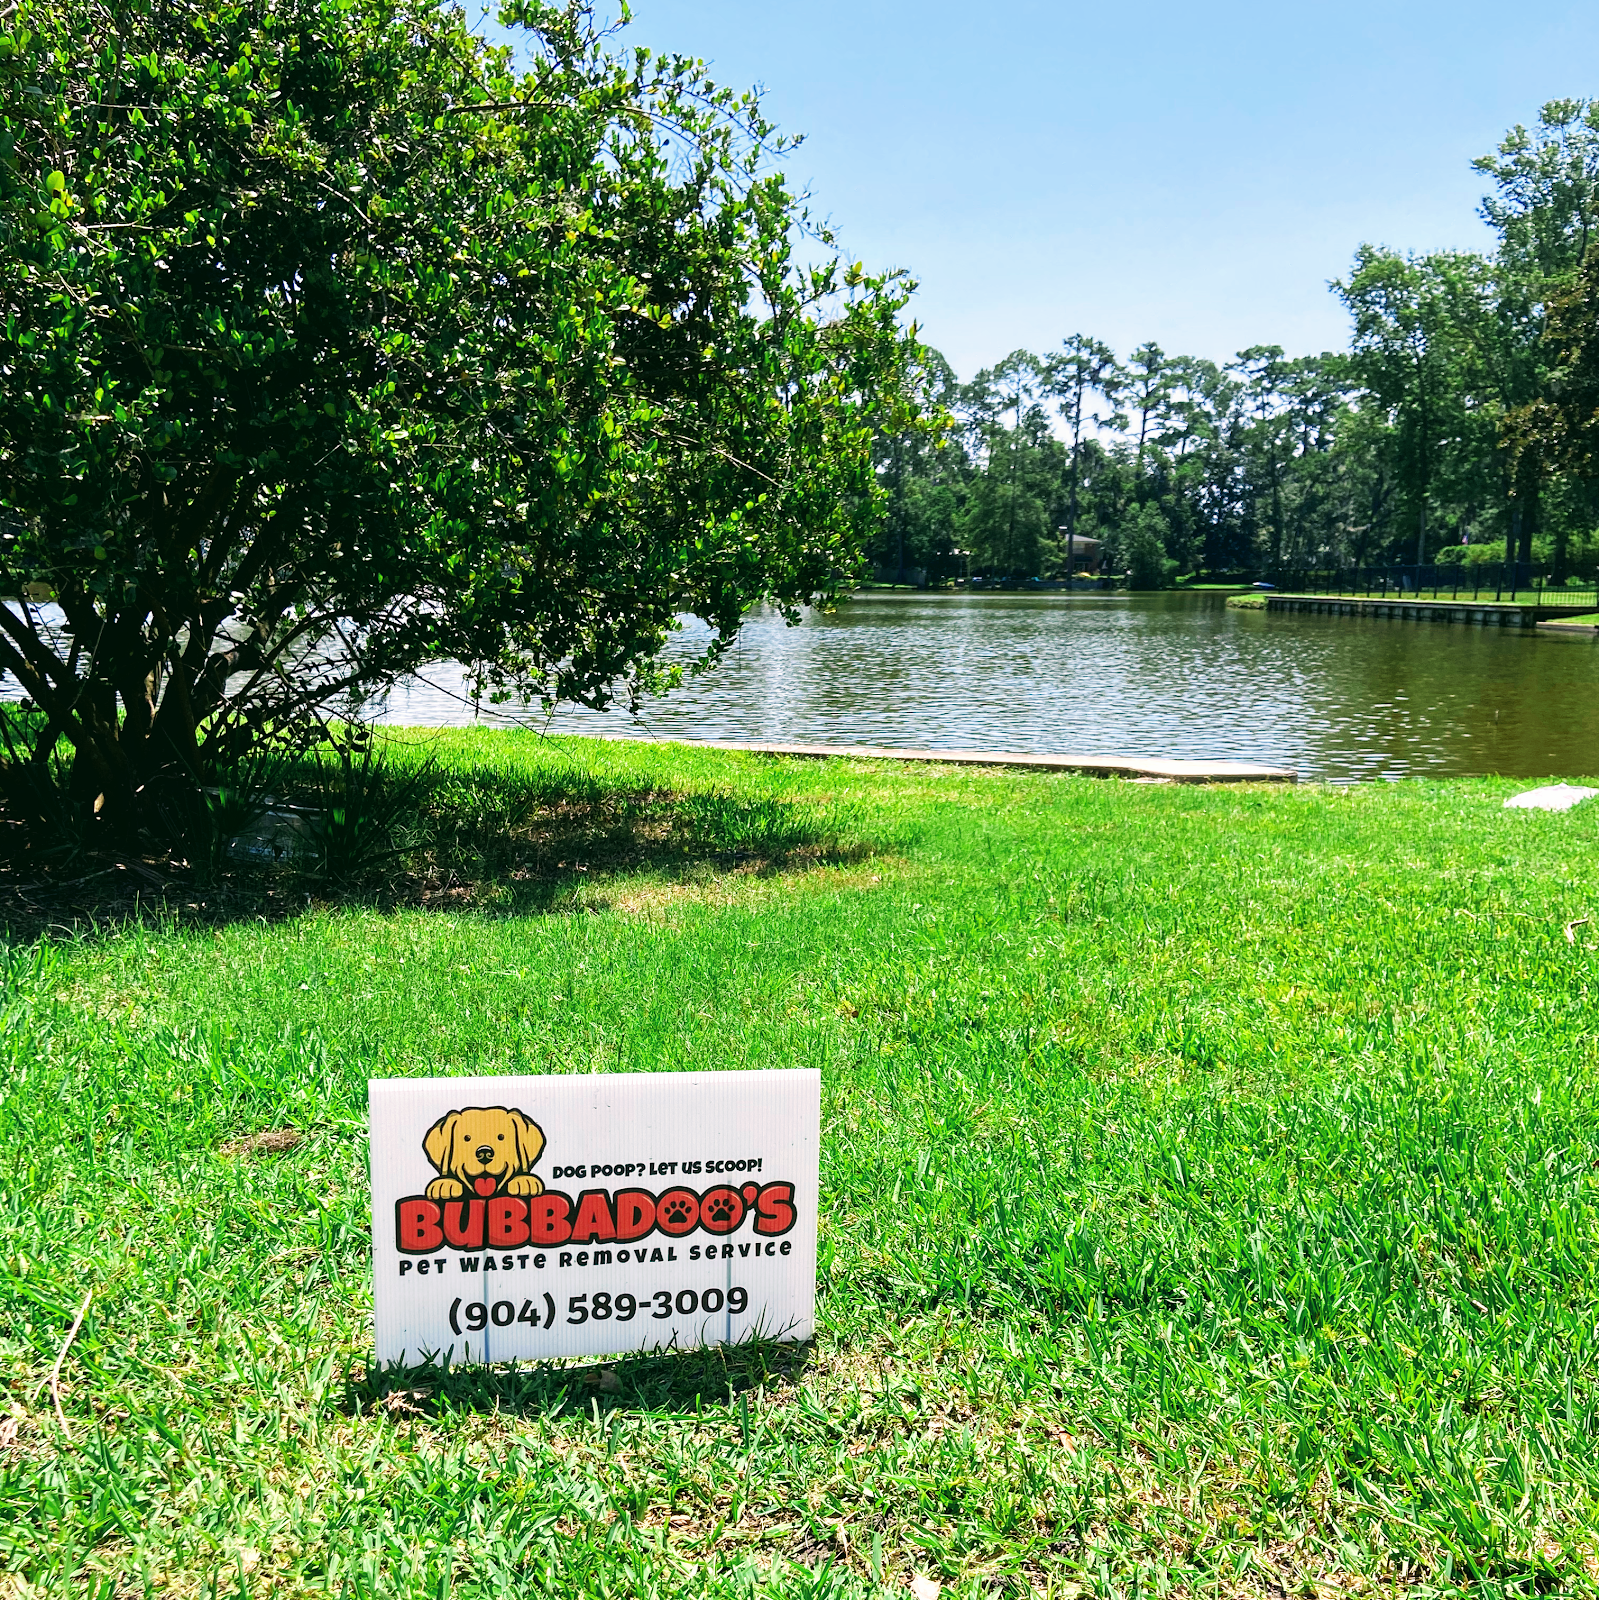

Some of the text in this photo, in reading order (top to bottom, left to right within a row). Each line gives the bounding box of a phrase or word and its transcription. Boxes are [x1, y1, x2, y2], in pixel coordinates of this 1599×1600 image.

[552, 1165, 587, 1179] DOG
[591, 1163, 646, 1178] POOP?
[705, 1158, 763, 1173] SCOOP!
[448, 1286, 749, 1336] (904) 589-3009
